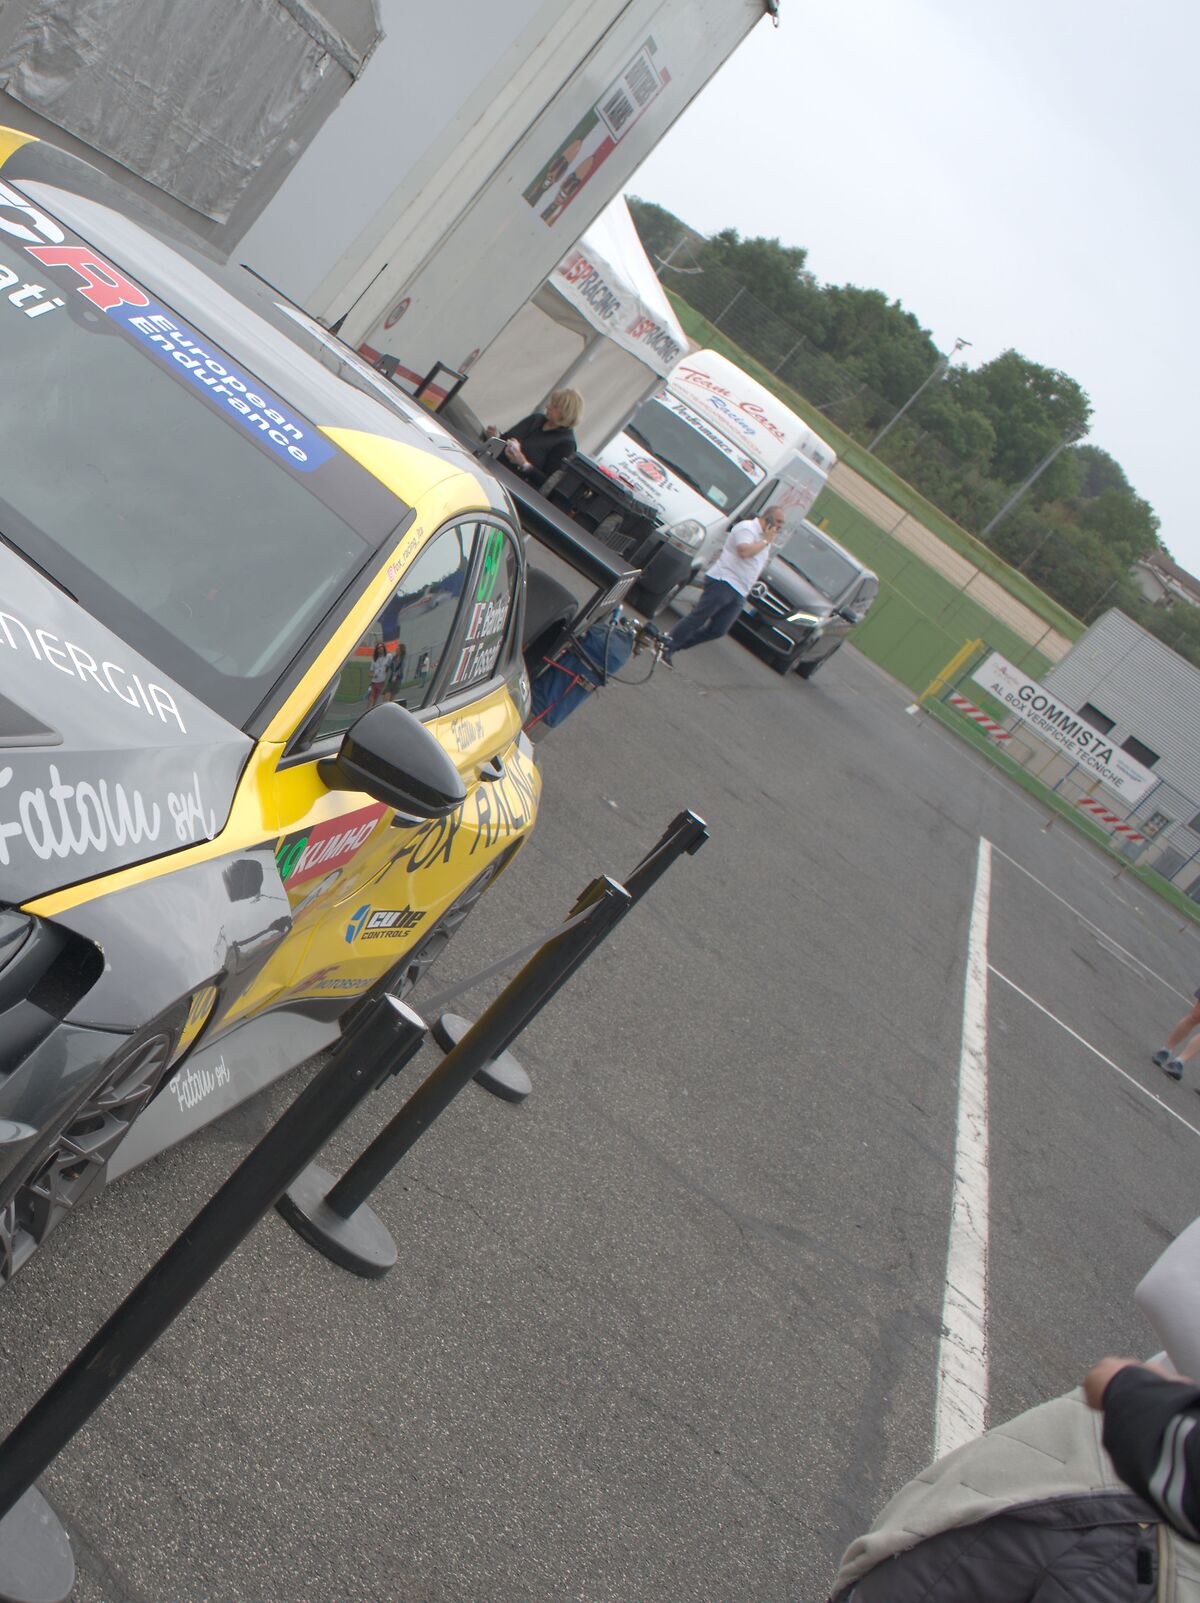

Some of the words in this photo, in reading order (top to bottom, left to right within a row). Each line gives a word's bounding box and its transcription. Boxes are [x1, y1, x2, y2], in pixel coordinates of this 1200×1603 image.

[128, 317, 308, 463] Endurance
[148, 315, 303, 440] European
[679, 367, 732, 397] Team
[739, 402, 786, 438] Cars
[672, 404, 733, 453] Performance
[707, 395, 756, 435] Racing
[477, 527, 504, 602] 69
[990, 683, 1003, 697] AL
[1004, 693, 1027, 713] BOX
[1027, 707, 1076, 752] VERIFICHE
[1077, 743, 1125, 788] TECNICHE
[1018, 685, 1115, 764] GOMMISTA
[291, 819, 379, 881] KUMHO
[361, 930, 411, 941] CONTROLS
[365, 904, 427, 930] cube
